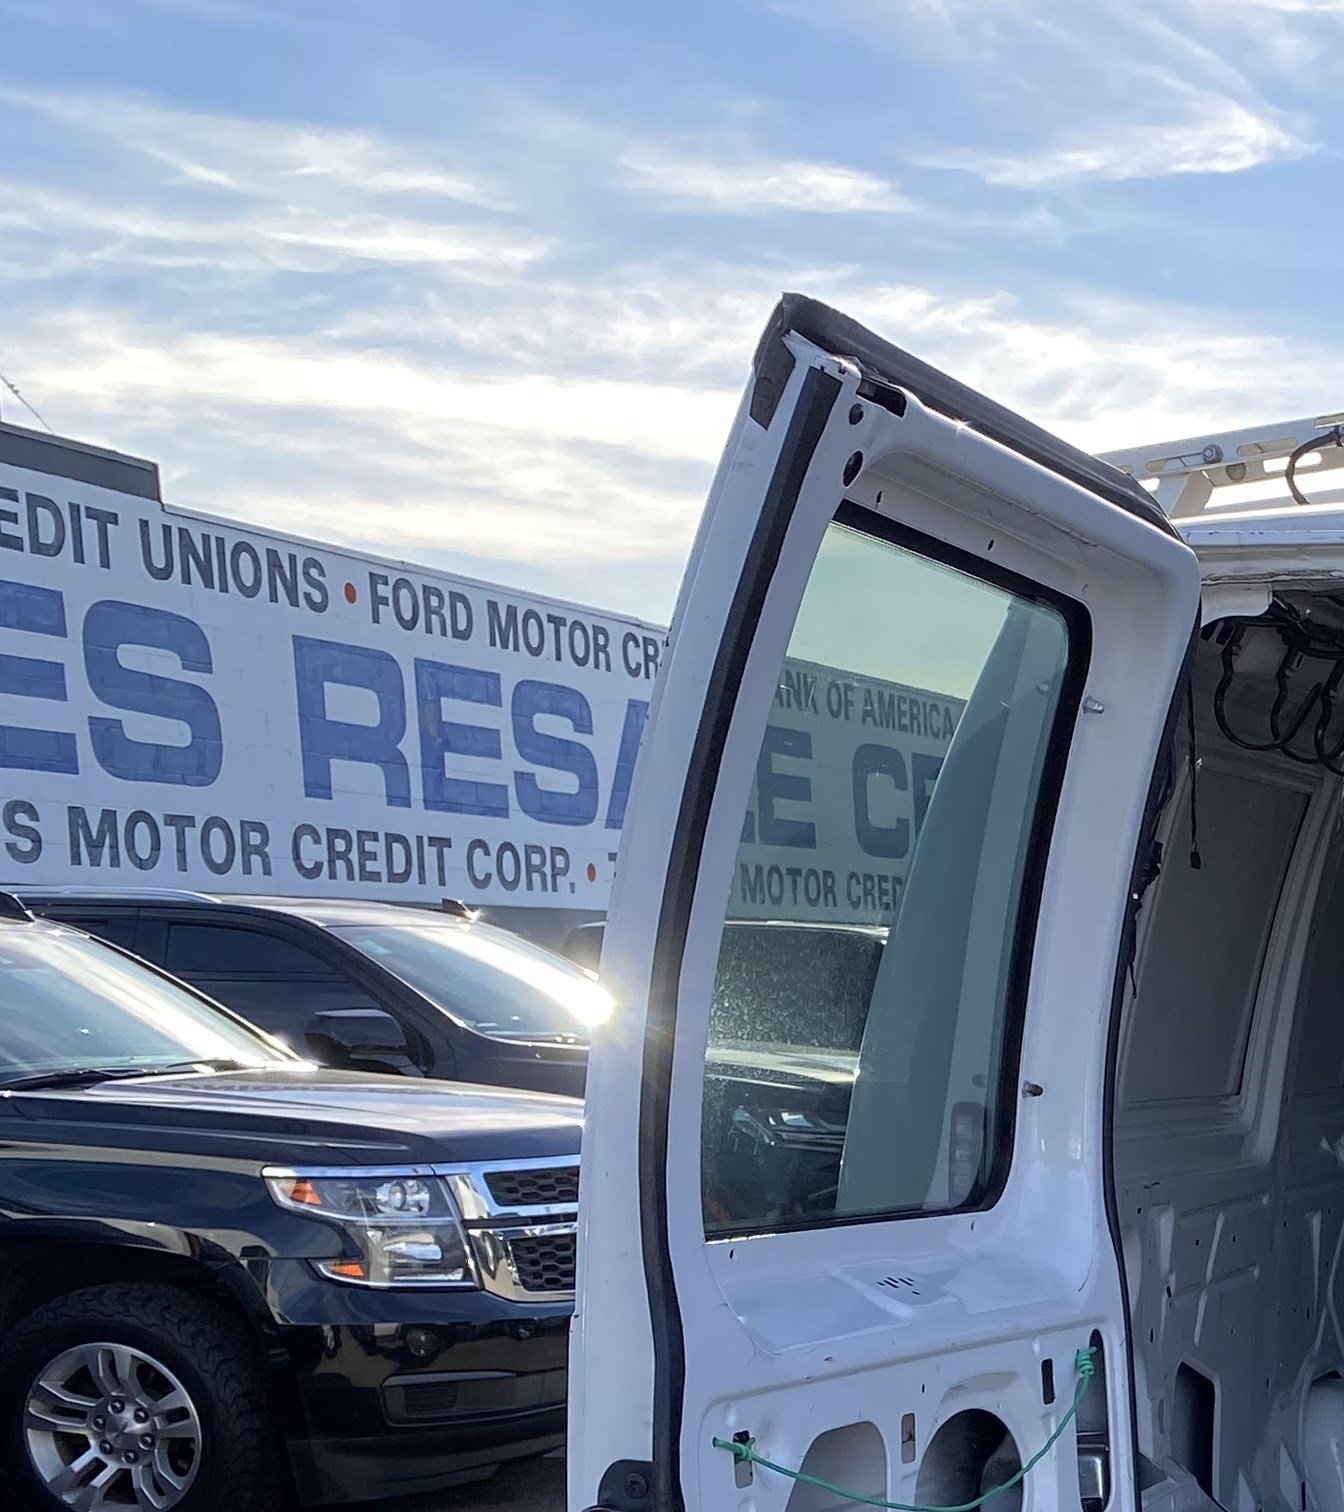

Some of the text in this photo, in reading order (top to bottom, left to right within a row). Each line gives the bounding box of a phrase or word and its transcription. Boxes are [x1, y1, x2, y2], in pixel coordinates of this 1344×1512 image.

[139, 518, 329, 613] UNIONS
[368, 571, 473, 641] FORD
[486, 599, 612, 672] MOTOR
[622, 631, 664, 680] CR
[826, 680, 854, 720] OF
[861, 687, 954, 740] AMERICA
[67, 806, 272, 876] MOTOR
[291, 823, 451, 887] CREDIT
[466, 838, 575, 894] CORP.
[740, 863, 837, 907] MOTOR
